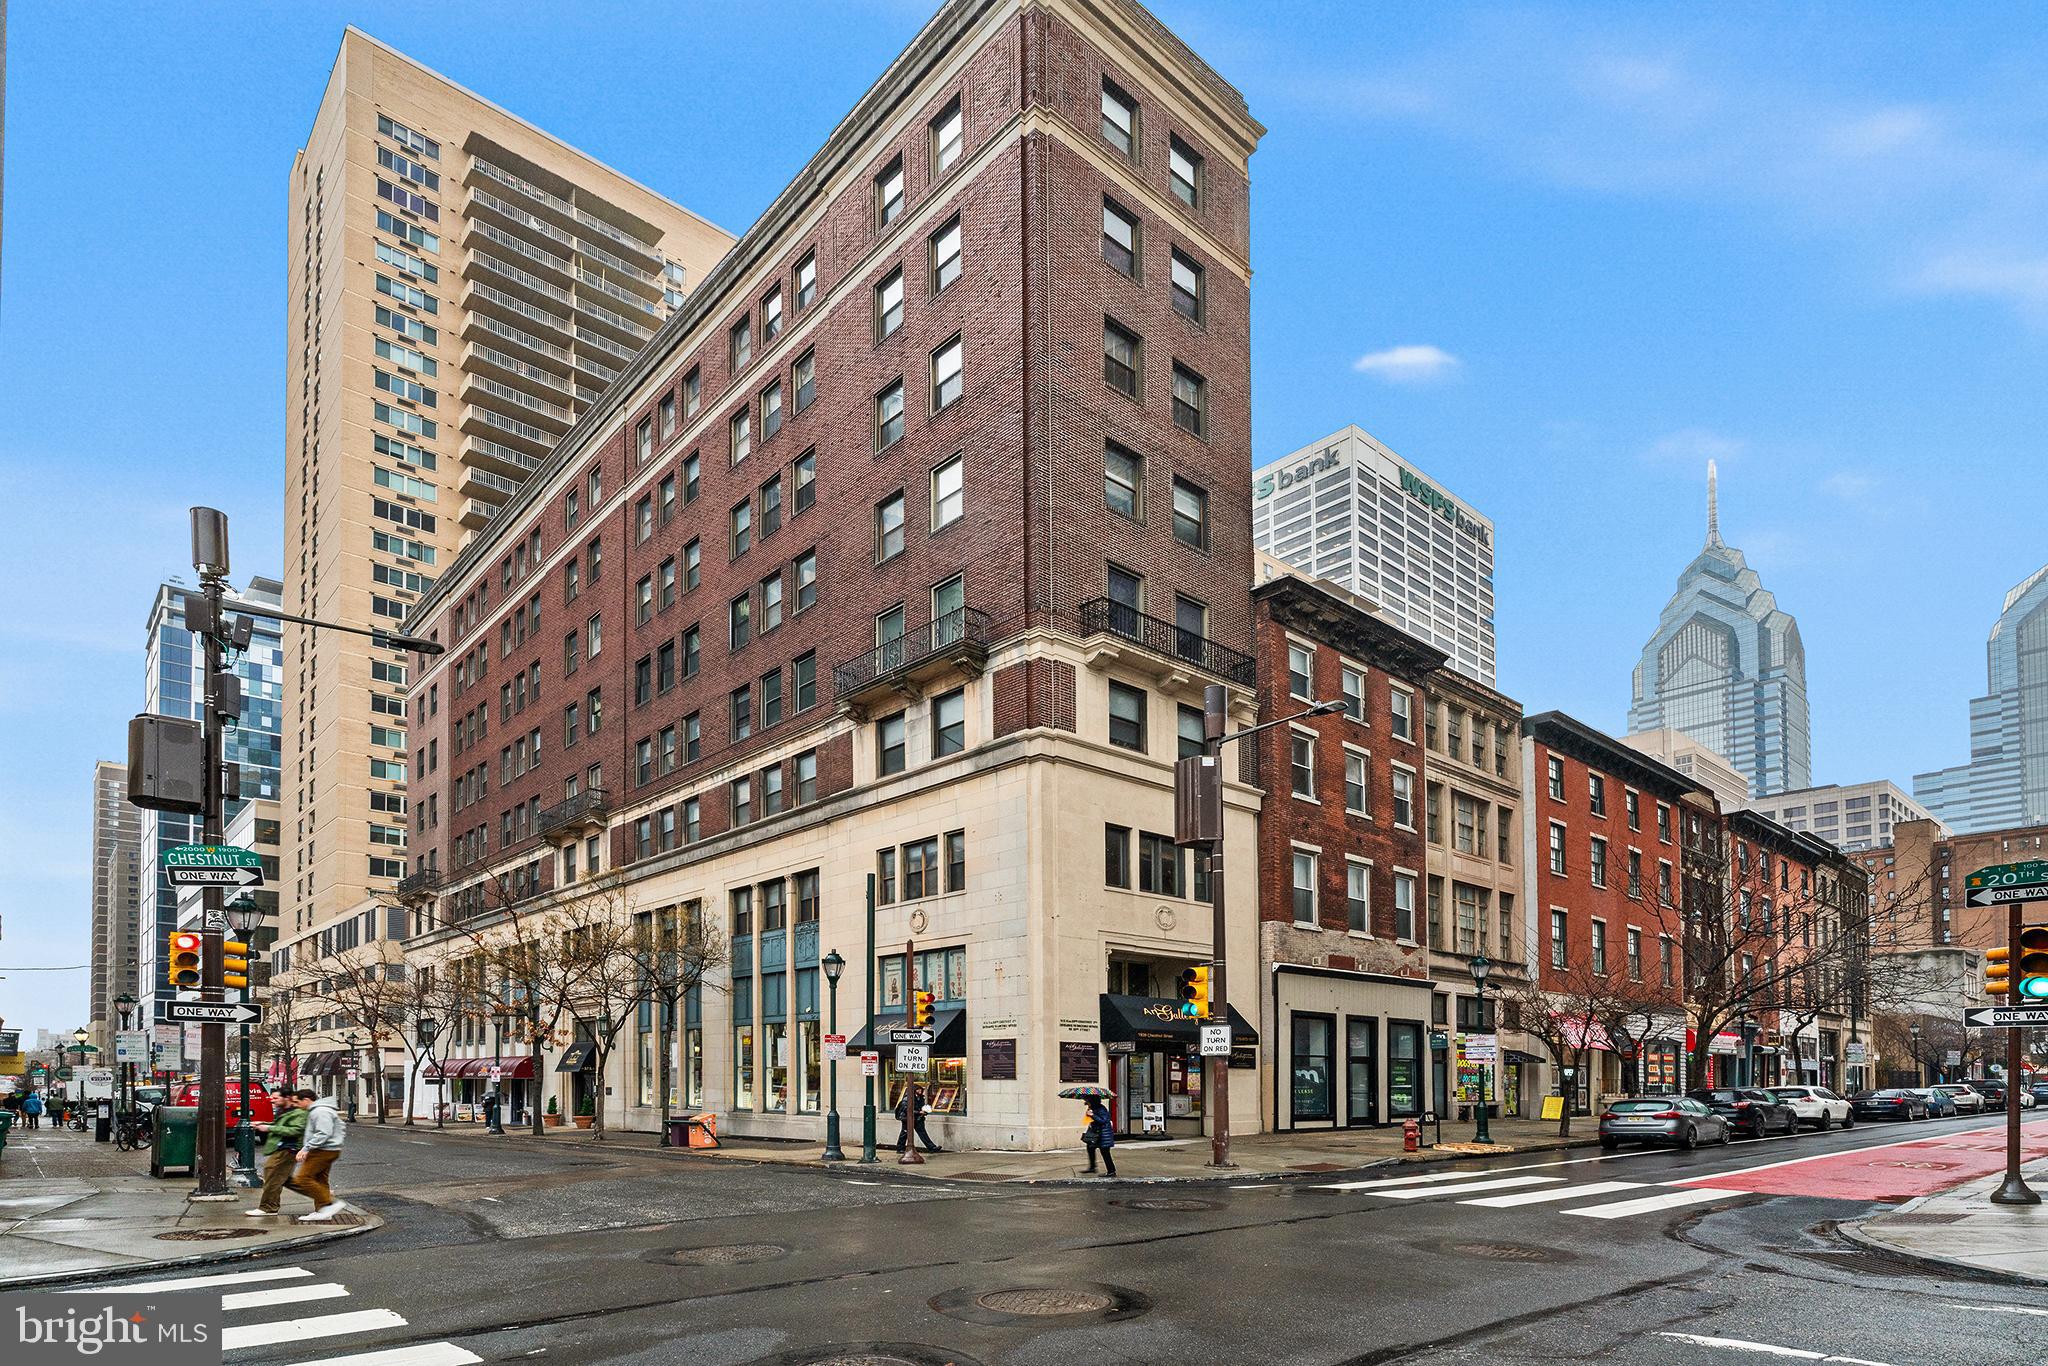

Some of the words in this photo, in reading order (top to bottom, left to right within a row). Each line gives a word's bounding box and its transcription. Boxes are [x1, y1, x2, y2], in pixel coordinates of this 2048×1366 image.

[1277, 447, 1340, 490] bank
[1399, 466, 1456, 522] WSFS
[1455, 506, 1490, 546] bank
[168, 853, 239, 866] CHESTNUT
[245, 858, 256, 866] ST
[179, 871, 207, 880] ONE
[209, 872, 236, 880] WAY
[1987, 870, 2035, 886] 20TH
[1994, 890, 2020, 900] ONE
[177, 1007, 203, 1016] ONE
[207, 1008, 233, 1017] WAY
[1993, 1012, 2020, 1021] ONE
